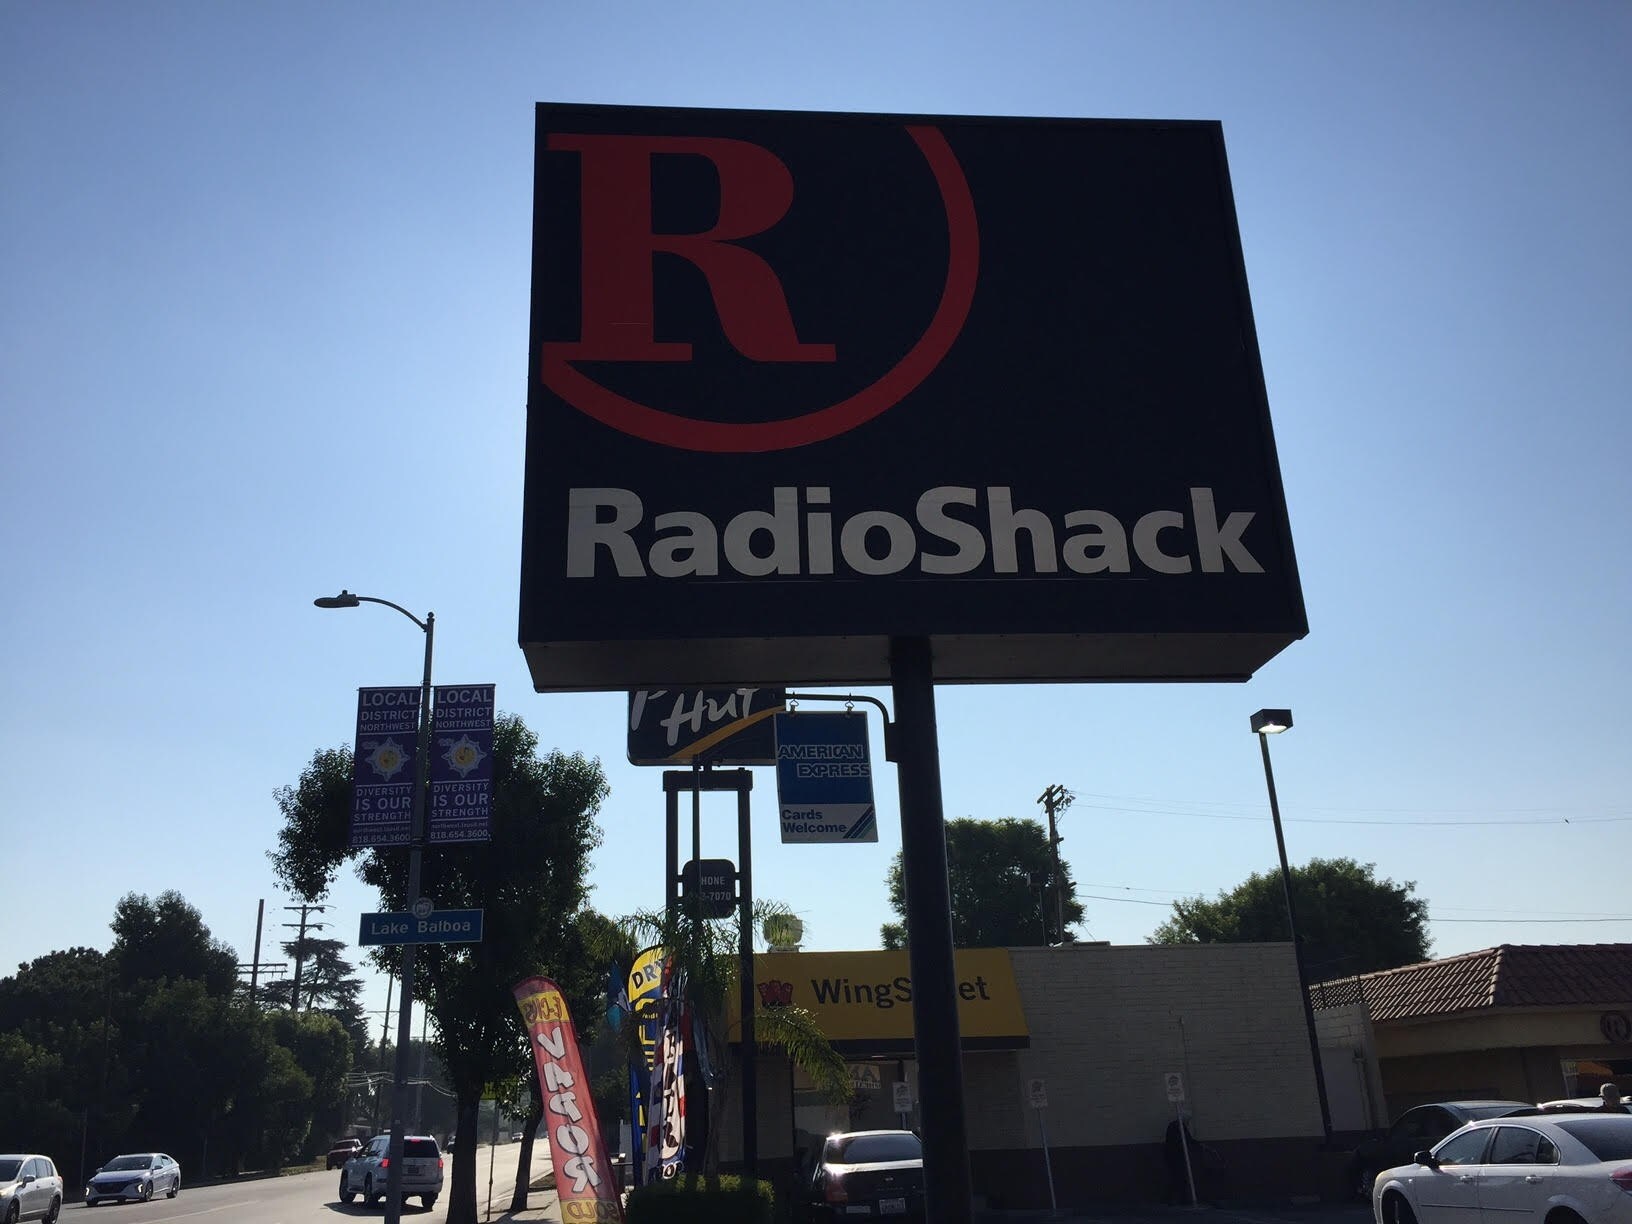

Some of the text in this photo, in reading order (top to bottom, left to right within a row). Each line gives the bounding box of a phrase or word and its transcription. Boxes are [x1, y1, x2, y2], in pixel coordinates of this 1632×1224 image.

[566, 486, 1266, 579] RadioShack
[362, 692, 419, 707] LOCAL
[437, 689, 492, 704] LOCAL
[361, 709, 418, 721] DISTRICT
[435, 706, 492, 718] DISTRICT
[360, 721, 415, 731] NORTHWEST
[435, 719, 491, 729] NORTHWEST
[777, 744, 863, 759] AMERICAN
[797, 762, 870, 778] EXPRESS
[356, 786, 413, 797] DIVERSITY
[433, 783, 489, 793] DIVERSITY
[355, 796, 412, 811] IS OUR
[433, 793, 488, 807] IS OUR
[352, 811, 411, 822] STRENGTH
[431, 807, 488, 818] STRENGTH
[782, 808, 823, 821] Cards
[783, 822, 847, 834] Welcome
[430, 830, 488, 840] 818.654.3600
[701, 876, 726, 886] HONE
[371, 920, 471, 935] Lake Balboa
[810, 976, 990, 1009] WingSet
